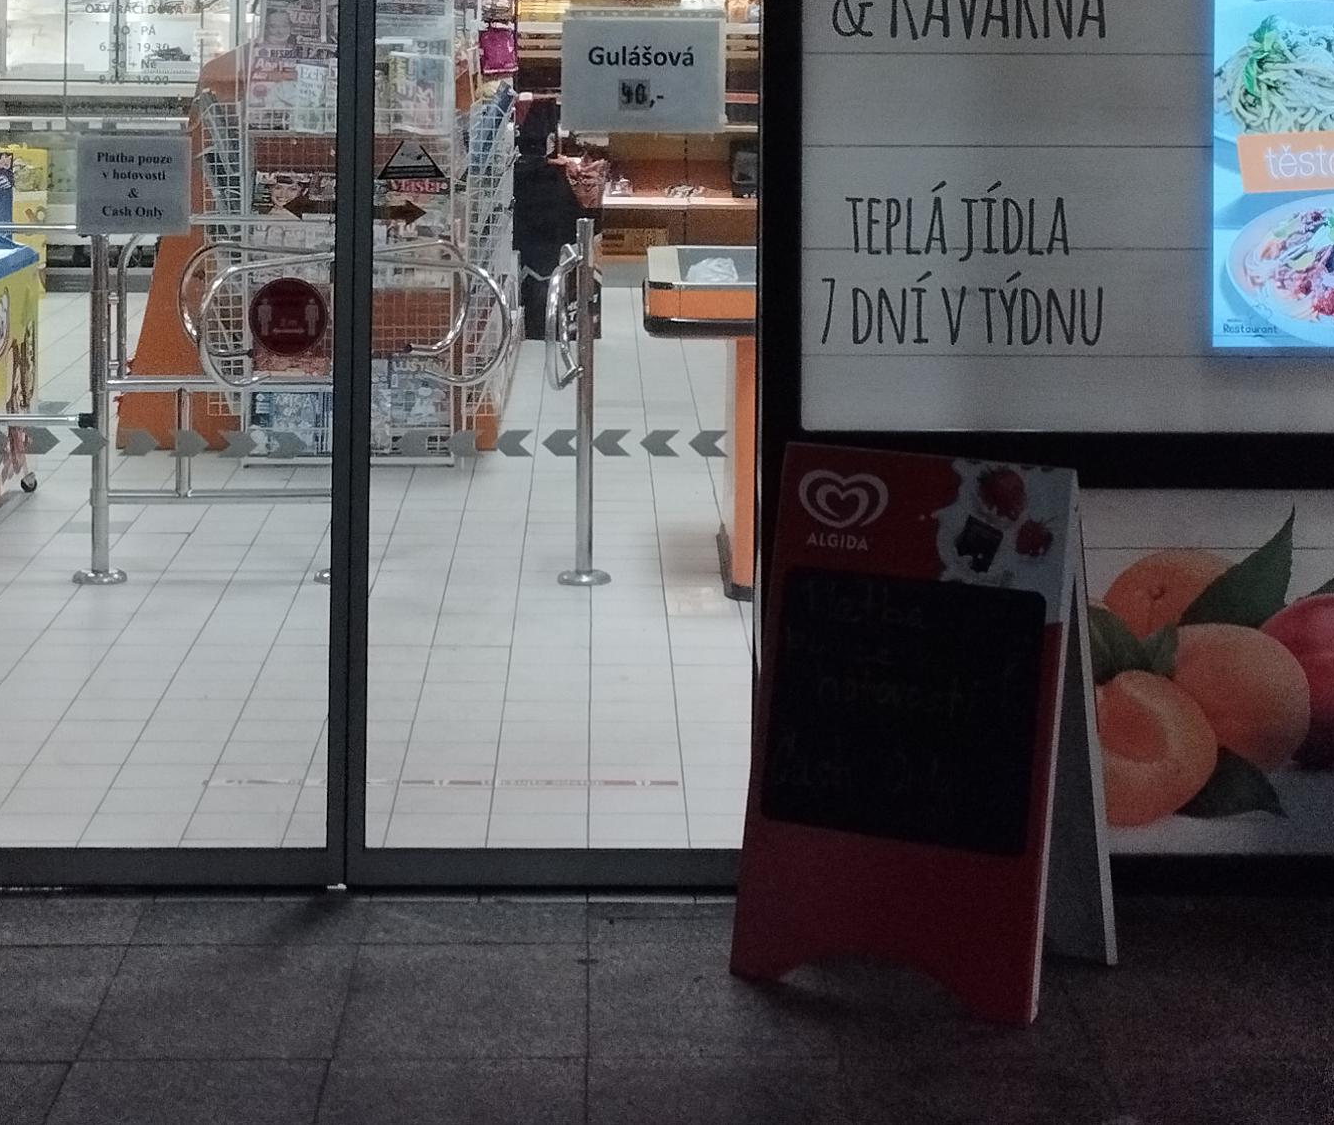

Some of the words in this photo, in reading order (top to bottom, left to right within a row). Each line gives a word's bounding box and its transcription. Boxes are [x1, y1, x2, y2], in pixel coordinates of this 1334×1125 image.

[588, 45, 695, 66] Gulášová
[97, 152, 134, 163] Platba
[138, 155, 172, 166] pouze
[112, 169, 166, 180] hotovosti
[127, 187, 139, 198] &
[102, 206, 132, 217] Cash
[135, 206, 163, 220] Only
[845, 180, 947, 256] TEPLÁ
[959, 180, 1070, 262] JÍDLA
[821, 278, 836, 344] 7
[852, 270, 933, 345] DNÍ
[940, 286, 967, 346] V
[978, 270, 1104, 346] TÝDNU
[1223, 323, 1277, 334] Restaurant
[806, 532, 868, 552] ALGIDA
